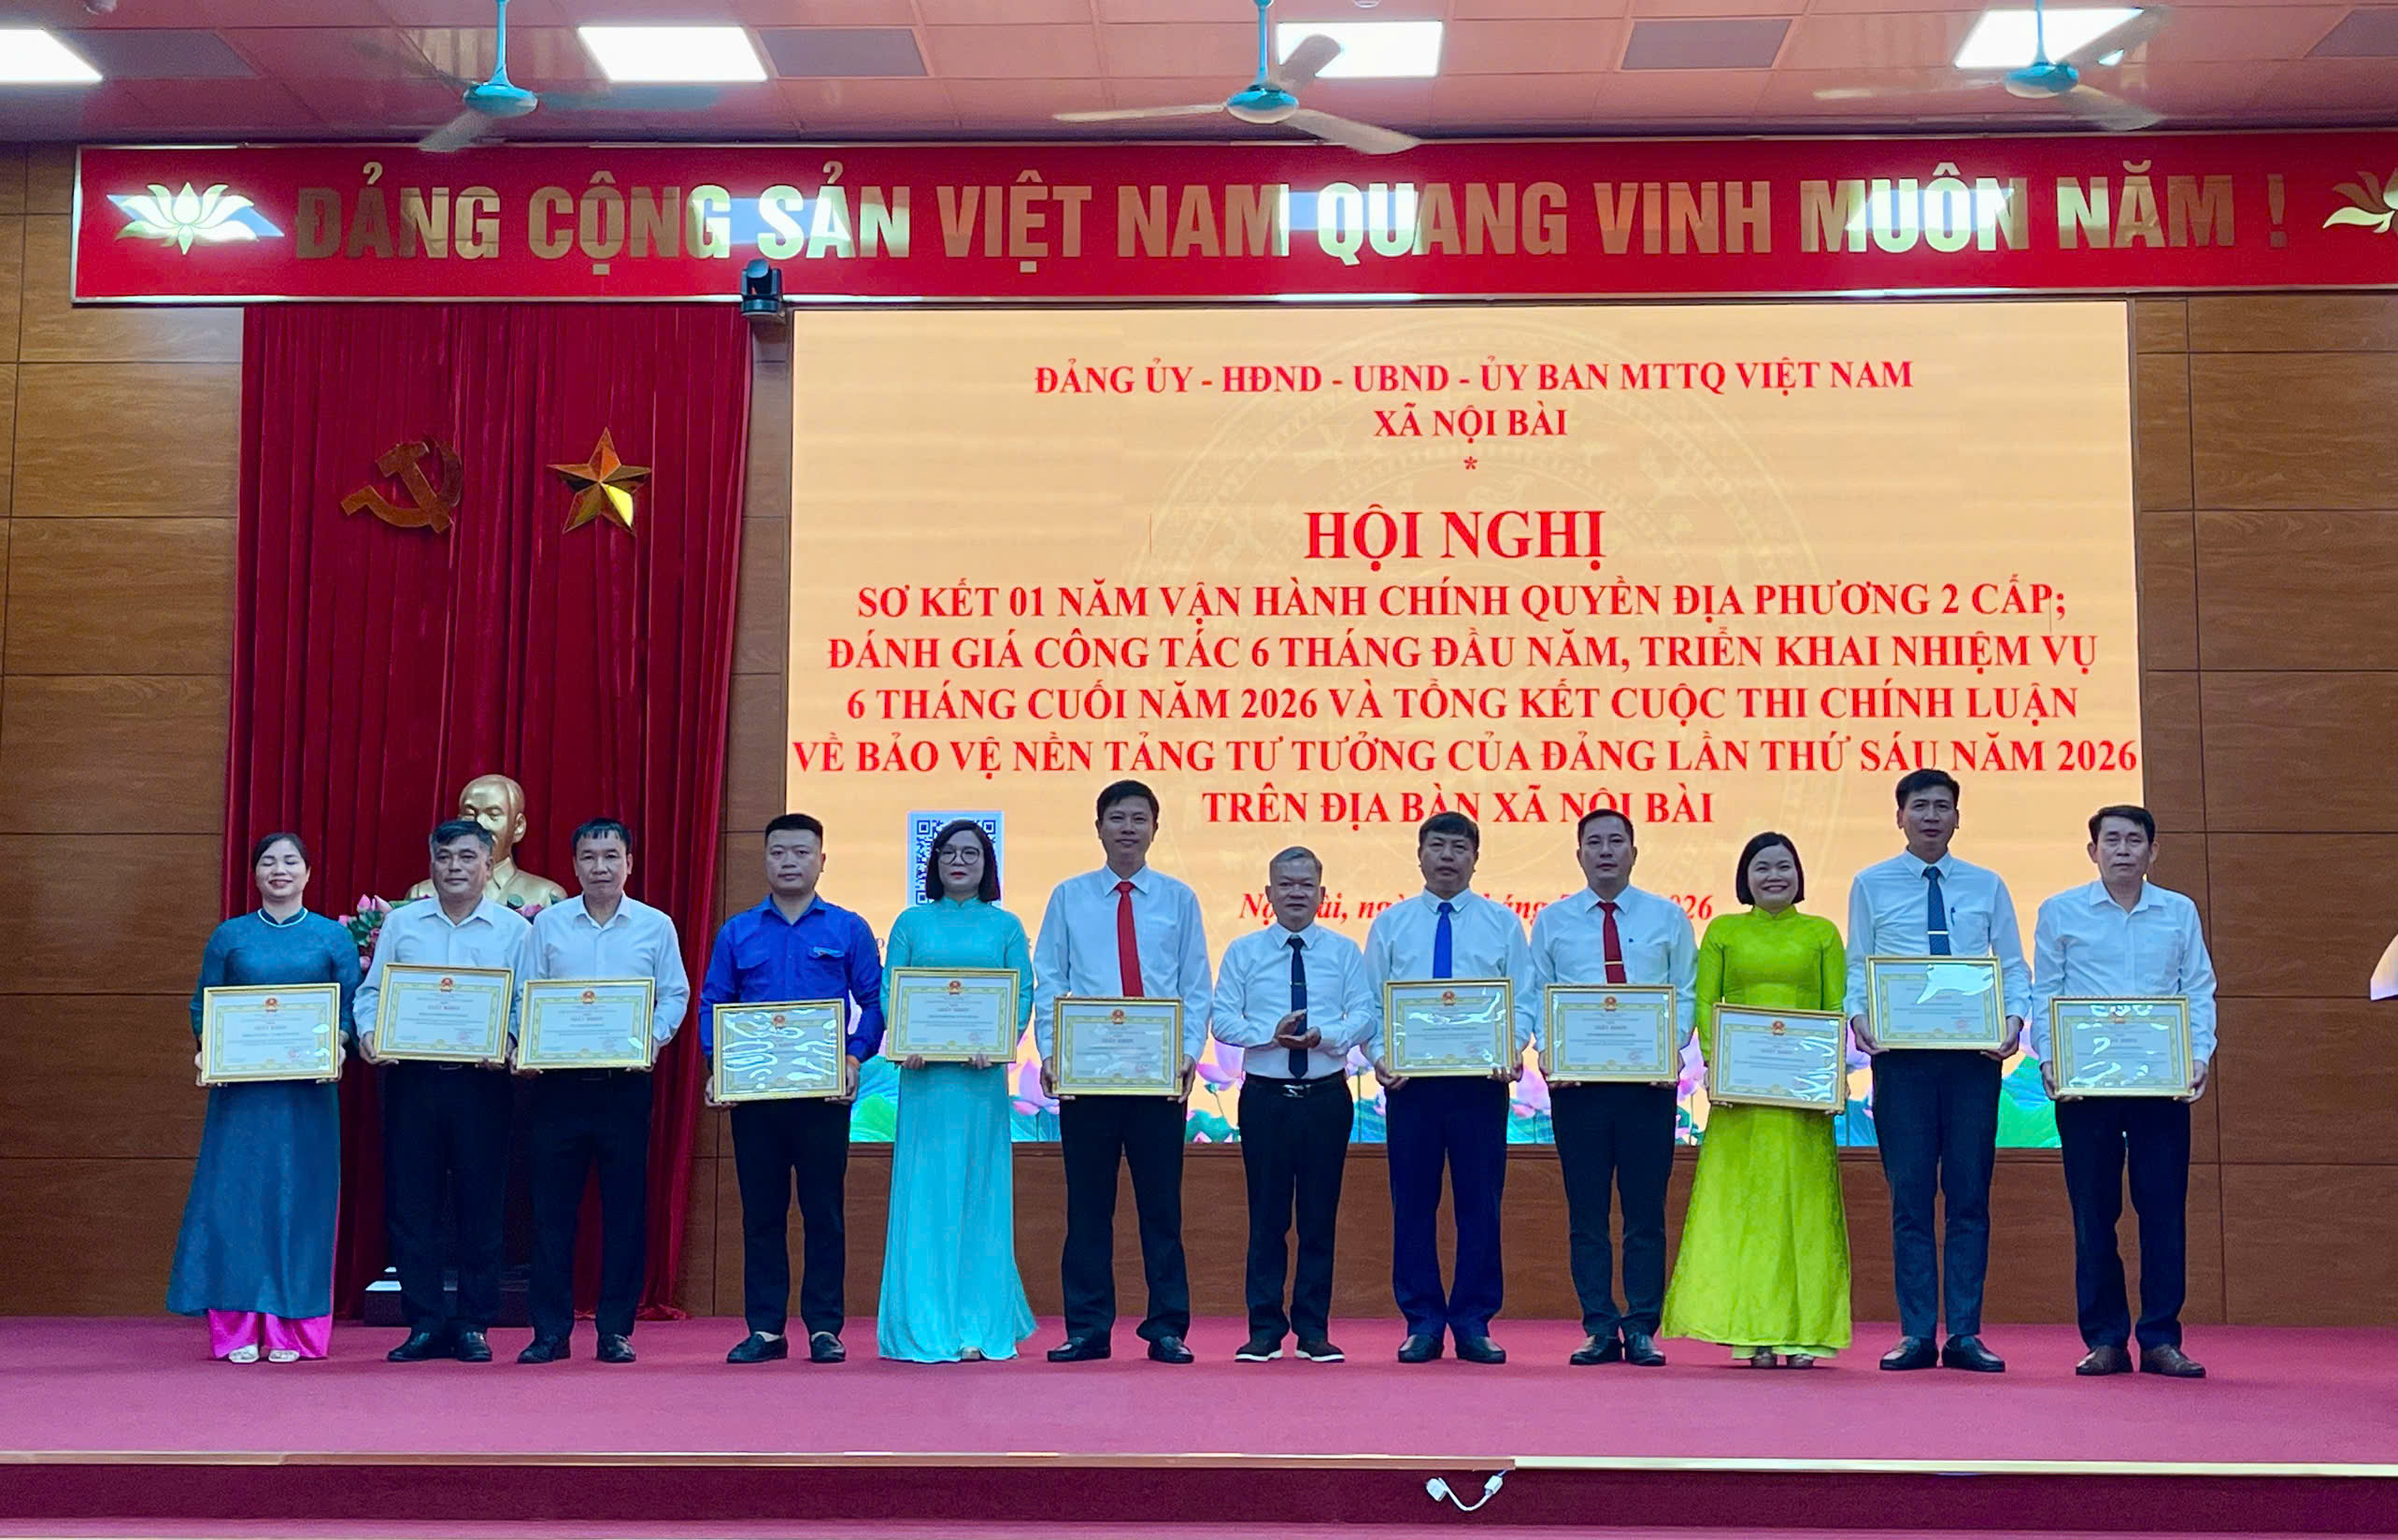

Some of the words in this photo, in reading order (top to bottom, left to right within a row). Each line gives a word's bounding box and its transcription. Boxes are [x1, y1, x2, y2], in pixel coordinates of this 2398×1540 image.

[296, 162, 500, 259] ĐẢNG
[529, 170, 731, 276] CỘNG
[758, 161, 910, 260] SẢN
[936, 169, 1092, 273] VIỆT
[1117, 184, 1290, 257] NAM
[1317, 182, 1567, 265] QUANG
[1593, 180, 1771, 254] VINH
[1800, 162, 2029, 253] MUÔN
[2057, 160, 2234, 250] NĂM
[1035, 359, 1135, 393] ĐẢNG
[1146, 358, 1192, 392] ỦY
[1222, 366, 1321, 392] HĐND
[1354, 365, 1449, 392] UBND
[1480, 356, 1528, 391] ỦY
[1538, 364, 1607, 390] BAN
[1620, 362, 1725, 394] MTTQ
[1734, 357, 1820, 396] VIỆT
[1830, 361, 1912, 388] NAM
[1374, 402, 1422, 436] XÃ
[1433, 405, 1495, 444] NỘI
[1507, 402, 1566, 435] BÀI
[1304, 504, 1422, 572] HỘI
[1440, 510, 1606, 571] NGHỊ
[859, 585, 909, 618] SƠ
[921, 578, 999, 617] KẾT
[1009, 587, 1043, 617] 01
[1058, 578, 1148, 617] NĂM
[1159, 581, 1241, 625] VẬN
[1254, 577, 1367, 616] HÀNH
[1379, 576, 1509, 616] CHÍNH
[1521, 576, 1660, 621] QUYỀN
[1674, 585, 1745, 623] ĐỊA
[1755, 579, 1929, 615] PHƯƠNG
[1942, 583, 1959, 614] 2
[1972, 574, 2065, 620] CẤP;
[829, 629, 939, 668] ĐÁNH
[951, 628, 1023, 668] GIÁ
[1035, 628, 1149, 668] CÔNG
[1159, 628, 1239, 667] TÁC
[1251, 637, 1269, 666] 6
[1279, 628, 1420, 667] THÁNG
[1431, 627, 1515, 667] ĐẦU
[1527, 628, 1630, 673] NĂM,
[1640, 627, 1763, 666] TRIỂN
[1777, 635, 1878, 666] KHAI
[1891, 631, 2030, 675] NHIỆM
[2041, 635, 2096, 675] VỤ
[848, 690, 865, 719] 6
[876, 680, 1017, 720] THÁNG
[1028, 679, 1126, 720] CUỐI
[1138, 680, 1229, 718] NĂM
[1241, 688, 1317, 718] 2026
[1328, 678, 1383, 718] VÀ
[1393, 678, 1506, 718] TỔNG
[1520, 678, 1600, 718] KẾT
[1611, 683, 1725, 726] CUỘC
[1737, 688, 1807, 718] THI
[1820, 677, 1953, 718] CHÍNH
[1966, 682, 2077, 726] LUẬN
[792, 733, 844, 772] VỀ
[857, 733, 938, 772] BẢO
[949, 736, 1001, 779] VỆ
[1013, 732, 1092, 771] NỀN
[1105, 732, 1215, 771] TẢNG
[1226, 735, 1283, 771] TƯ
[1292, 731, 1435, 771] TƯỞNG
[1448, 732, 1532, 771] CỦA
[1541, 731, 1655, 771] ĐẢNG
[1667, 731, 1749, 770] LẦN
[1761, 731, 1851, 771] THỨ
[1861, 731, 1937, 771] SÁU
[1951, 732, 2044, 771] NĂM
[2058, 740, 2136, 771] 2026
[1202, 782, 1308, 822] TRÊN
[1320, 792, 1391, 831] ĐỊA
[1401, 783, 1480, 822] BÀN
[1493, 785, 1548, 822] XÃ
[1645, 782, 1713, 822] BÀI
